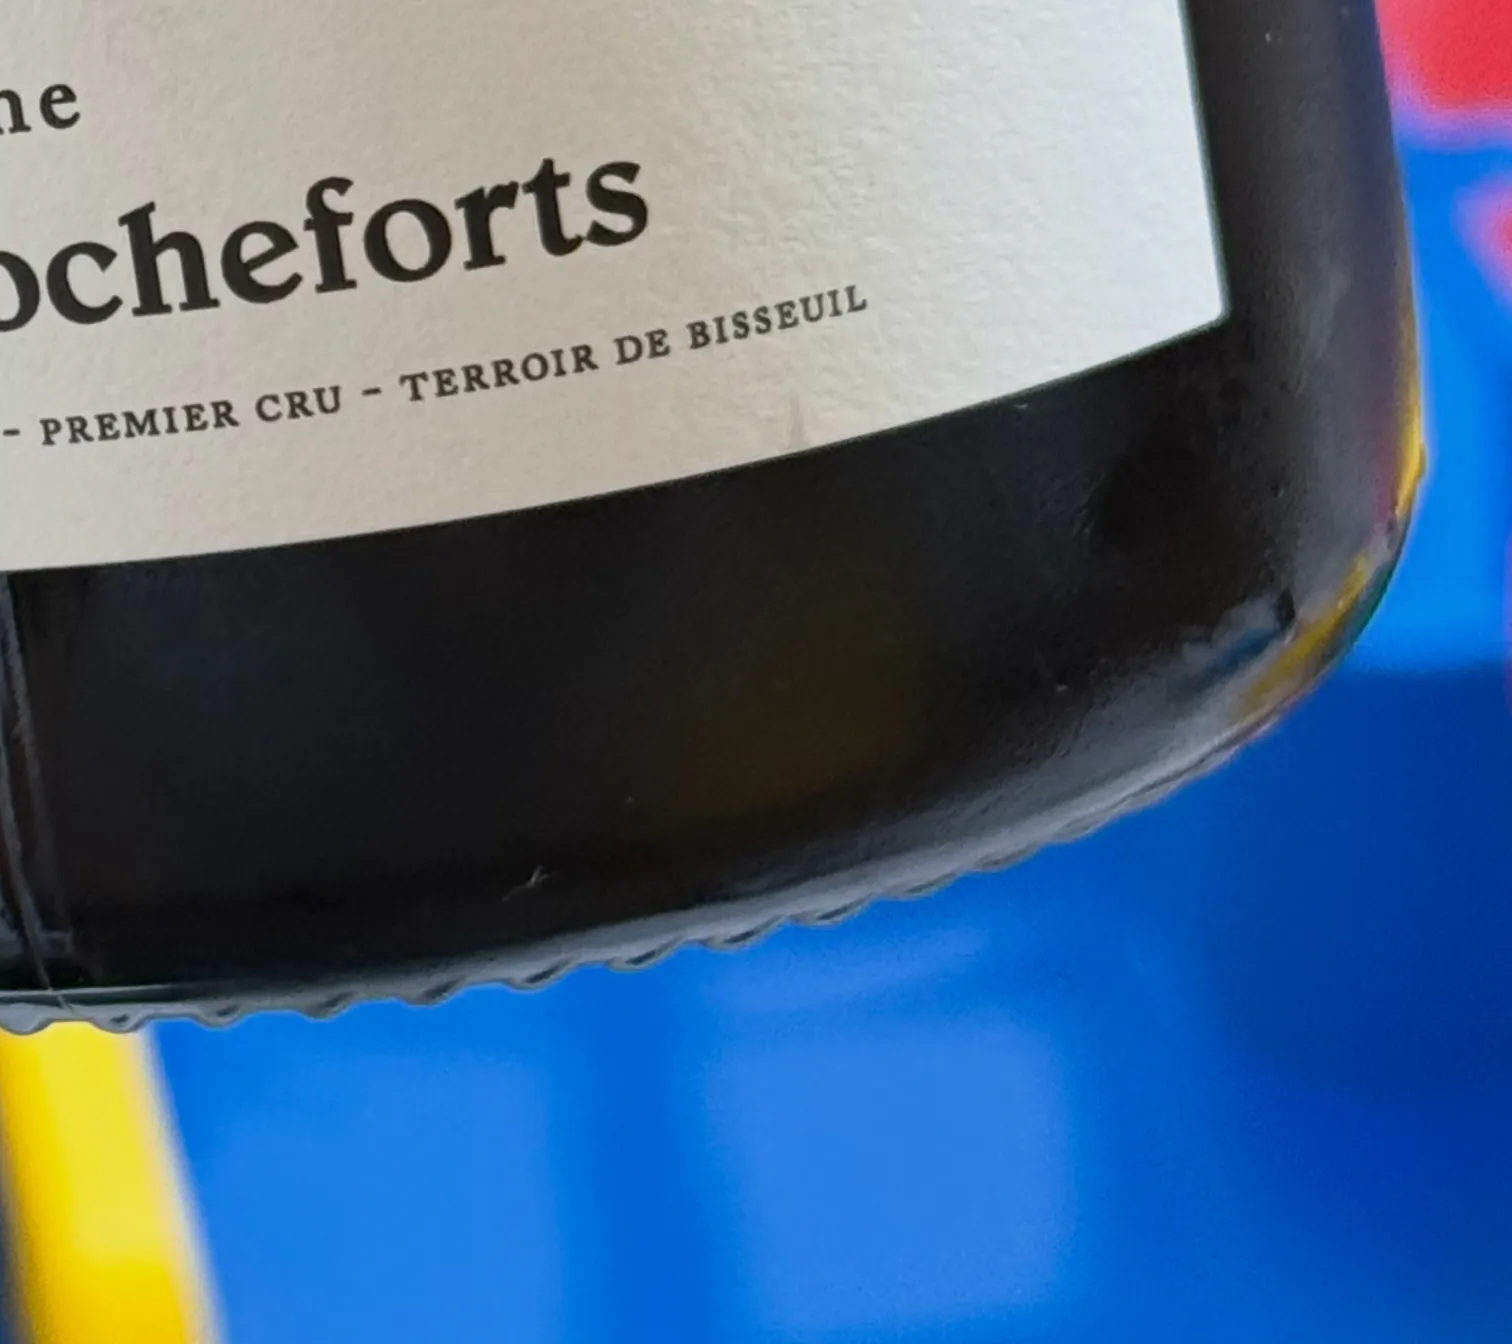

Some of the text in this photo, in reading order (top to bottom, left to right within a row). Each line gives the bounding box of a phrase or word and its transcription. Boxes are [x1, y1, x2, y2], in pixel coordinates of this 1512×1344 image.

[38, 399, 241, 447] PREMIER
[254, 384, 342, 423] CRU
[398, 343, 600, 403] TERROIR
[613, 328, 672, 366] DE
[686, 284, 868, 351] BISSEUIL
